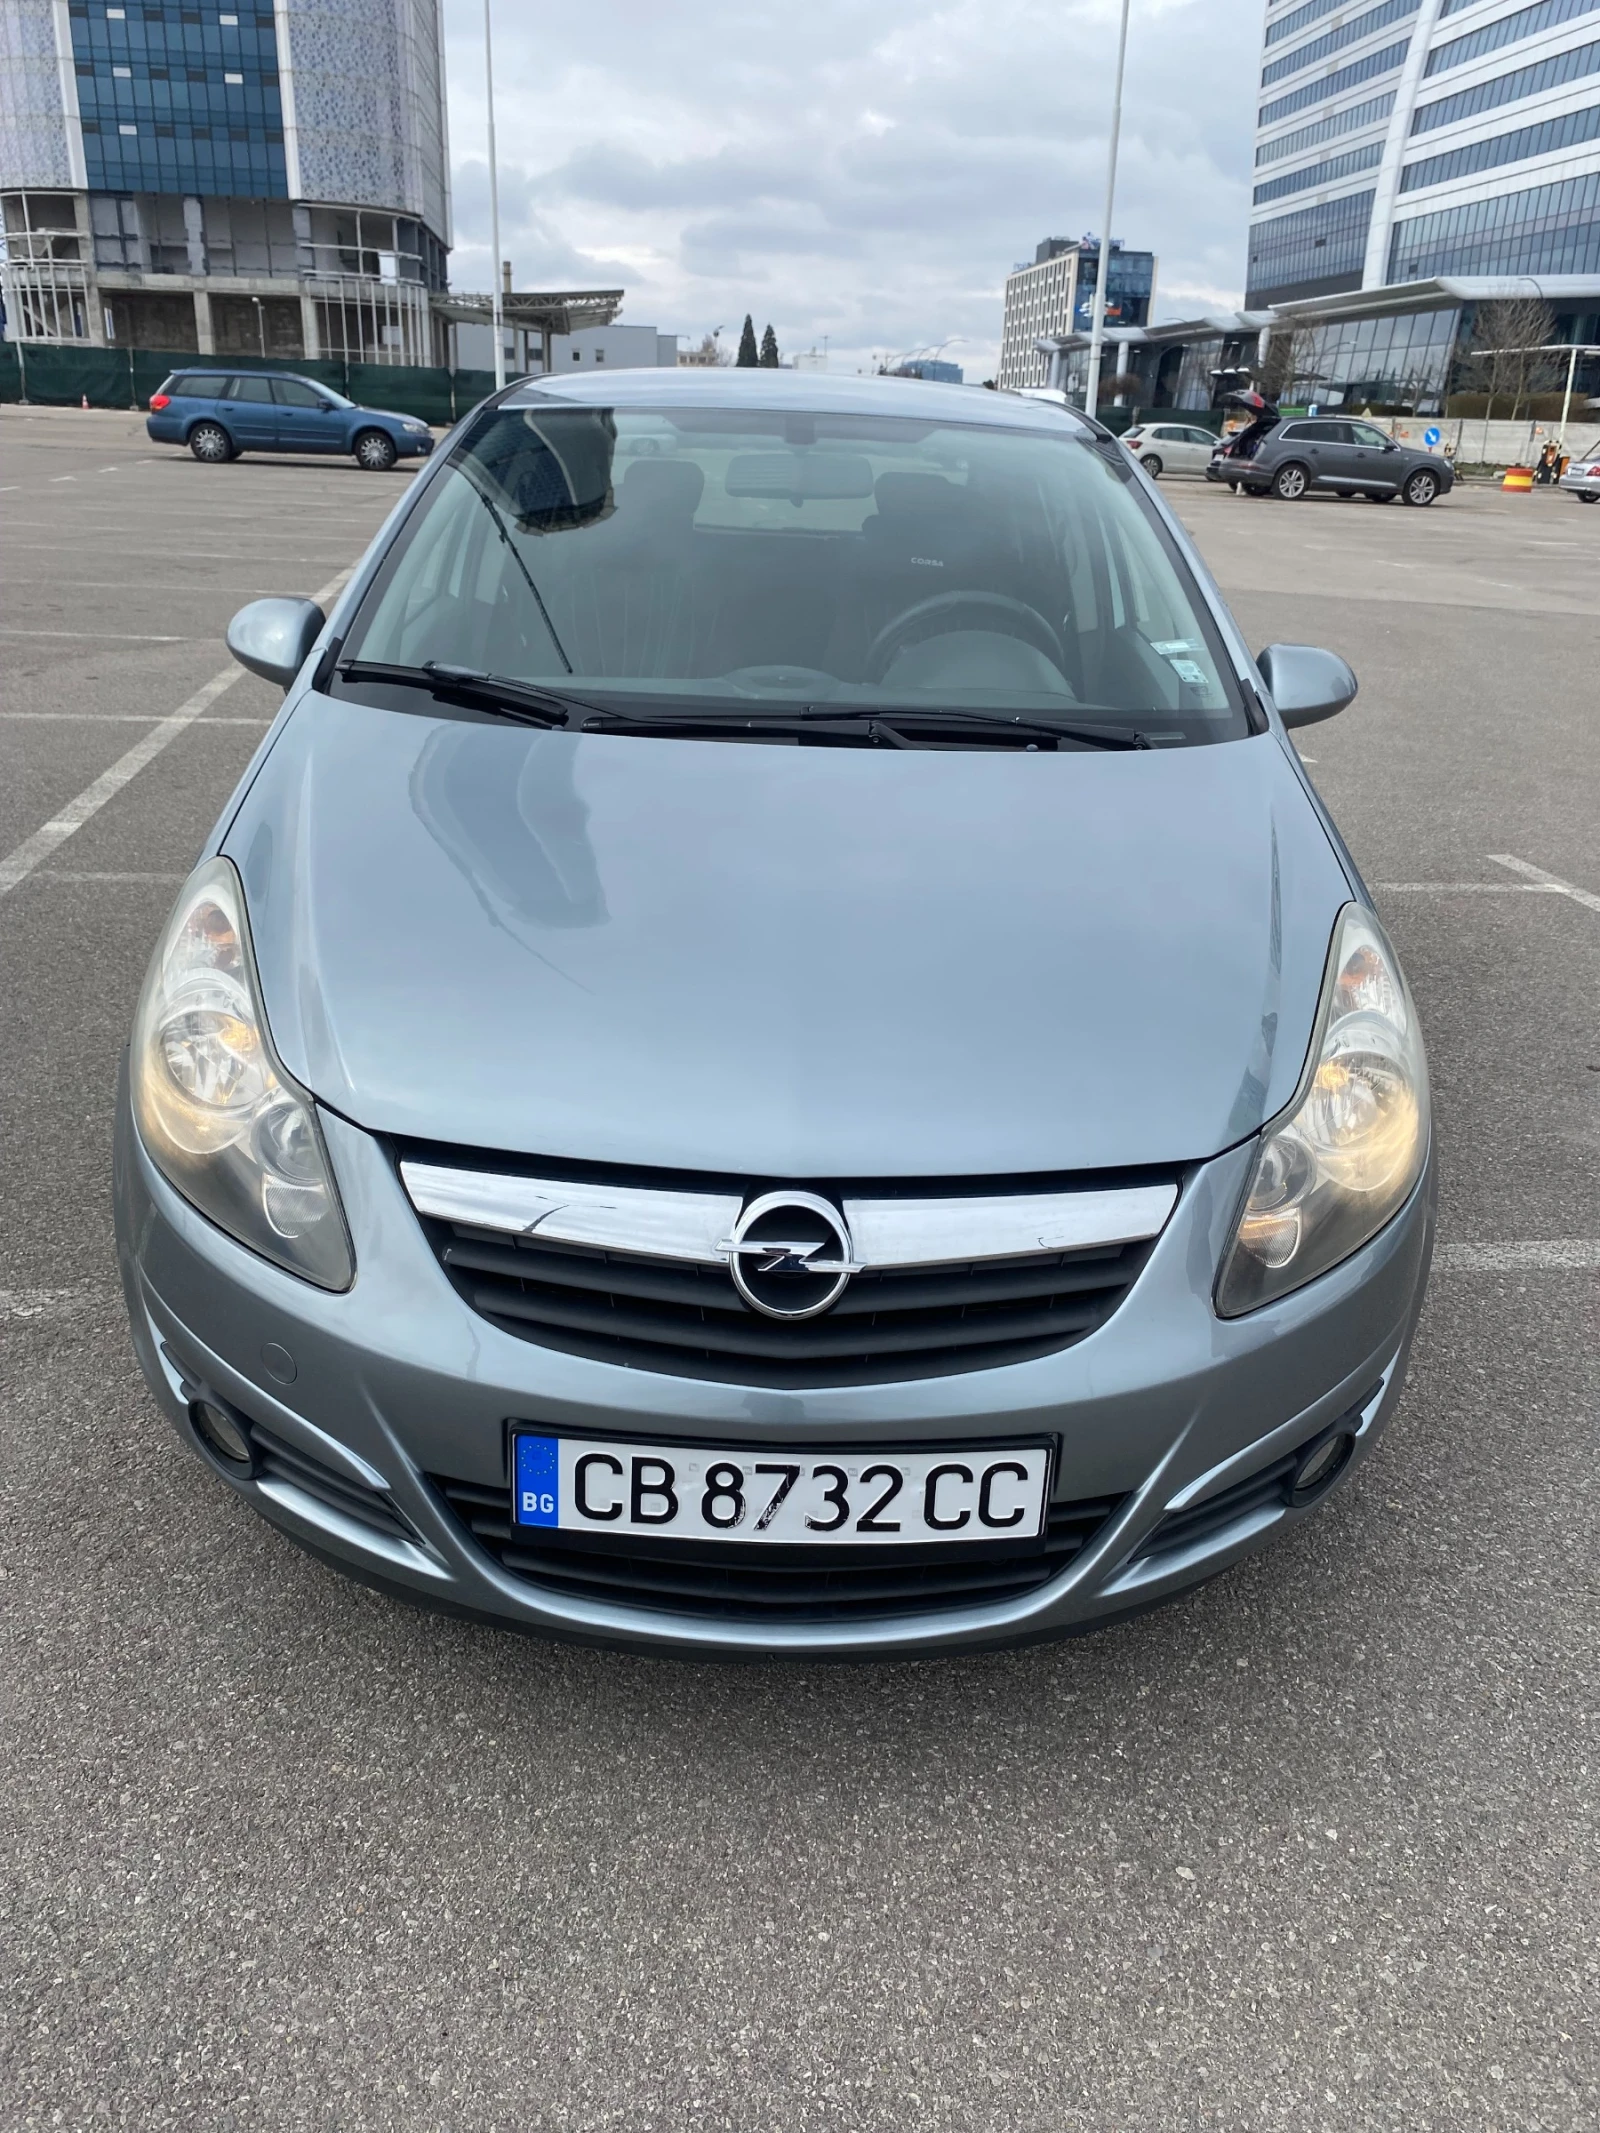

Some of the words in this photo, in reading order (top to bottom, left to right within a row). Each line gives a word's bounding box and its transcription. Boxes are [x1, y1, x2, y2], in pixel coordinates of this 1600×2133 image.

[910, 557, 944, 567] CORSA
[522, 1491, 554, 1514] BG
[574, 1453, 680, 1525] CB
[701, 1462, 904, 1533] 8732
[923, 1464, 1029, 1531] CC
